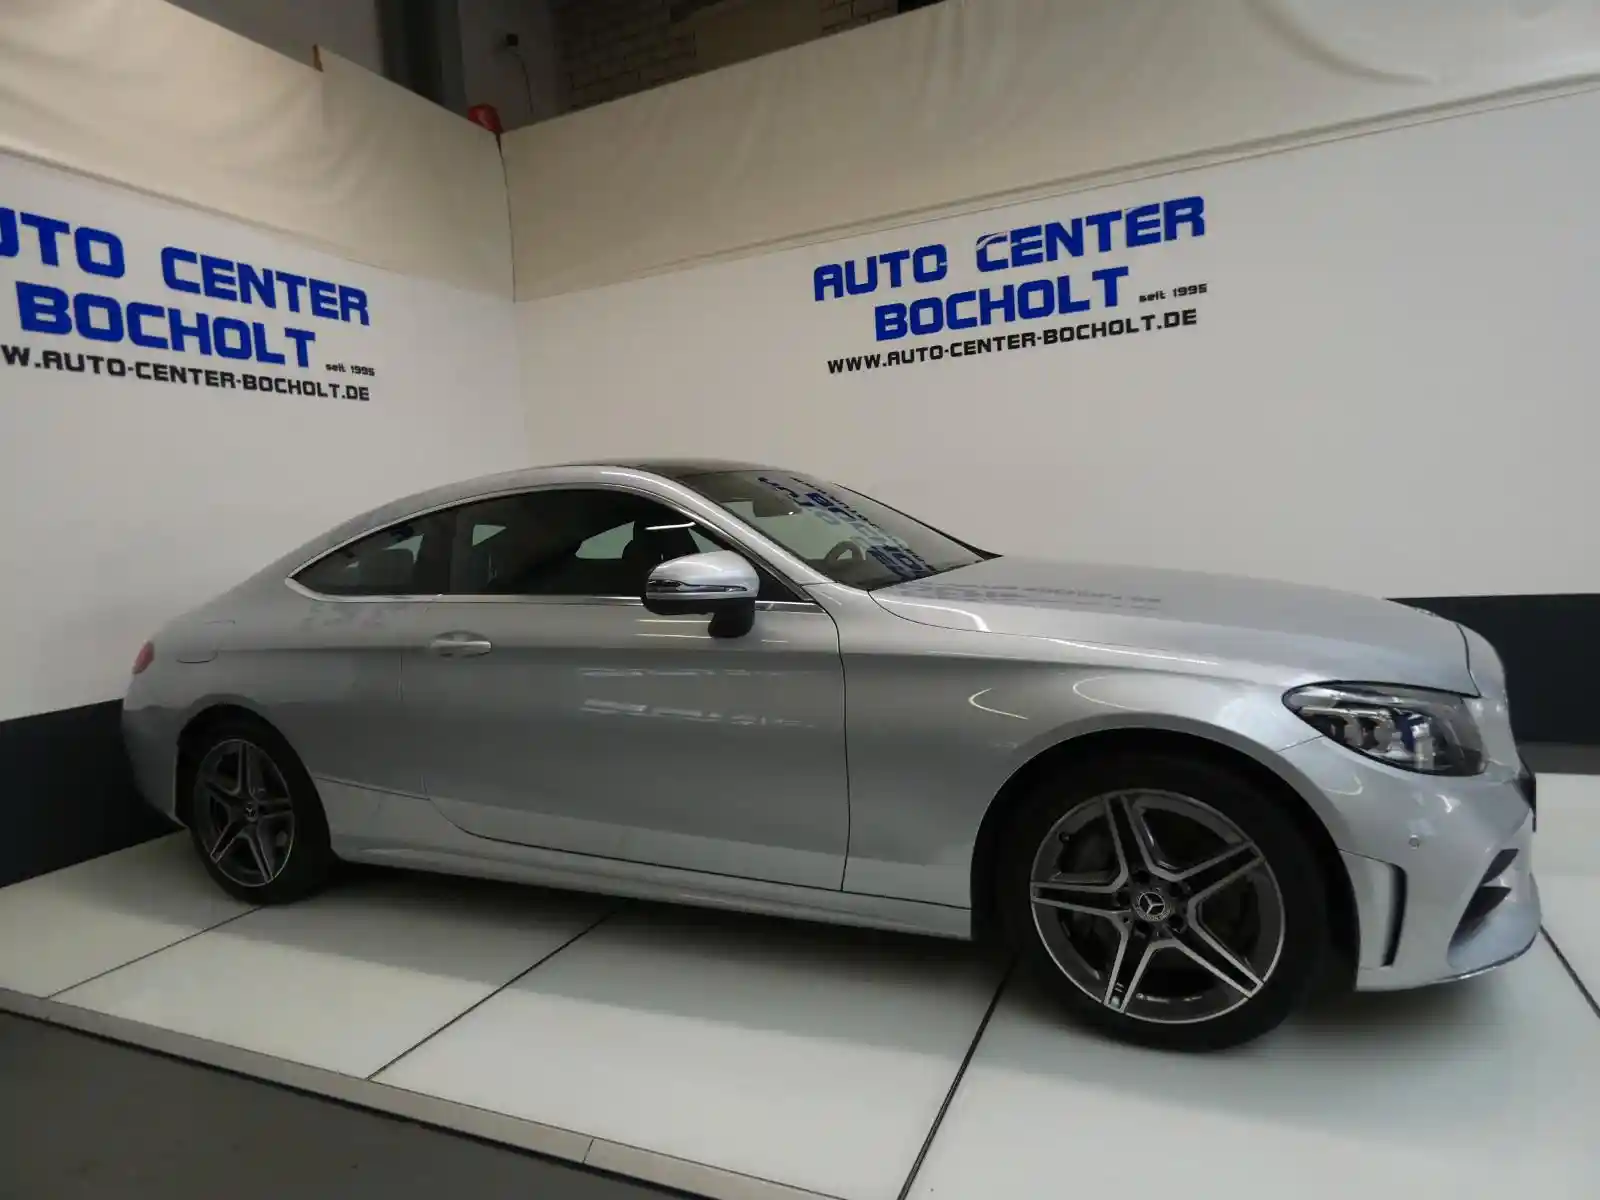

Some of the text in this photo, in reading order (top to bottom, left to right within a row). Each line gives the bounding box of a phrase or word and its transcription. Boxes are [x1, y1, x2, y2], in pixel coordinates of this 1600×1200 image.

[160, 246, 370, 326] CENTER
[813, 195, 1206, 301] AUTO CENTER
[15, 281, 376, 377] BOCHOLT seit 1995
[827, 307, 1197, 375] WWW.AUTO-CENTER-BOCHOLT.DE
[874, 265, 1208, 341] BOCHOLT seit 1995
